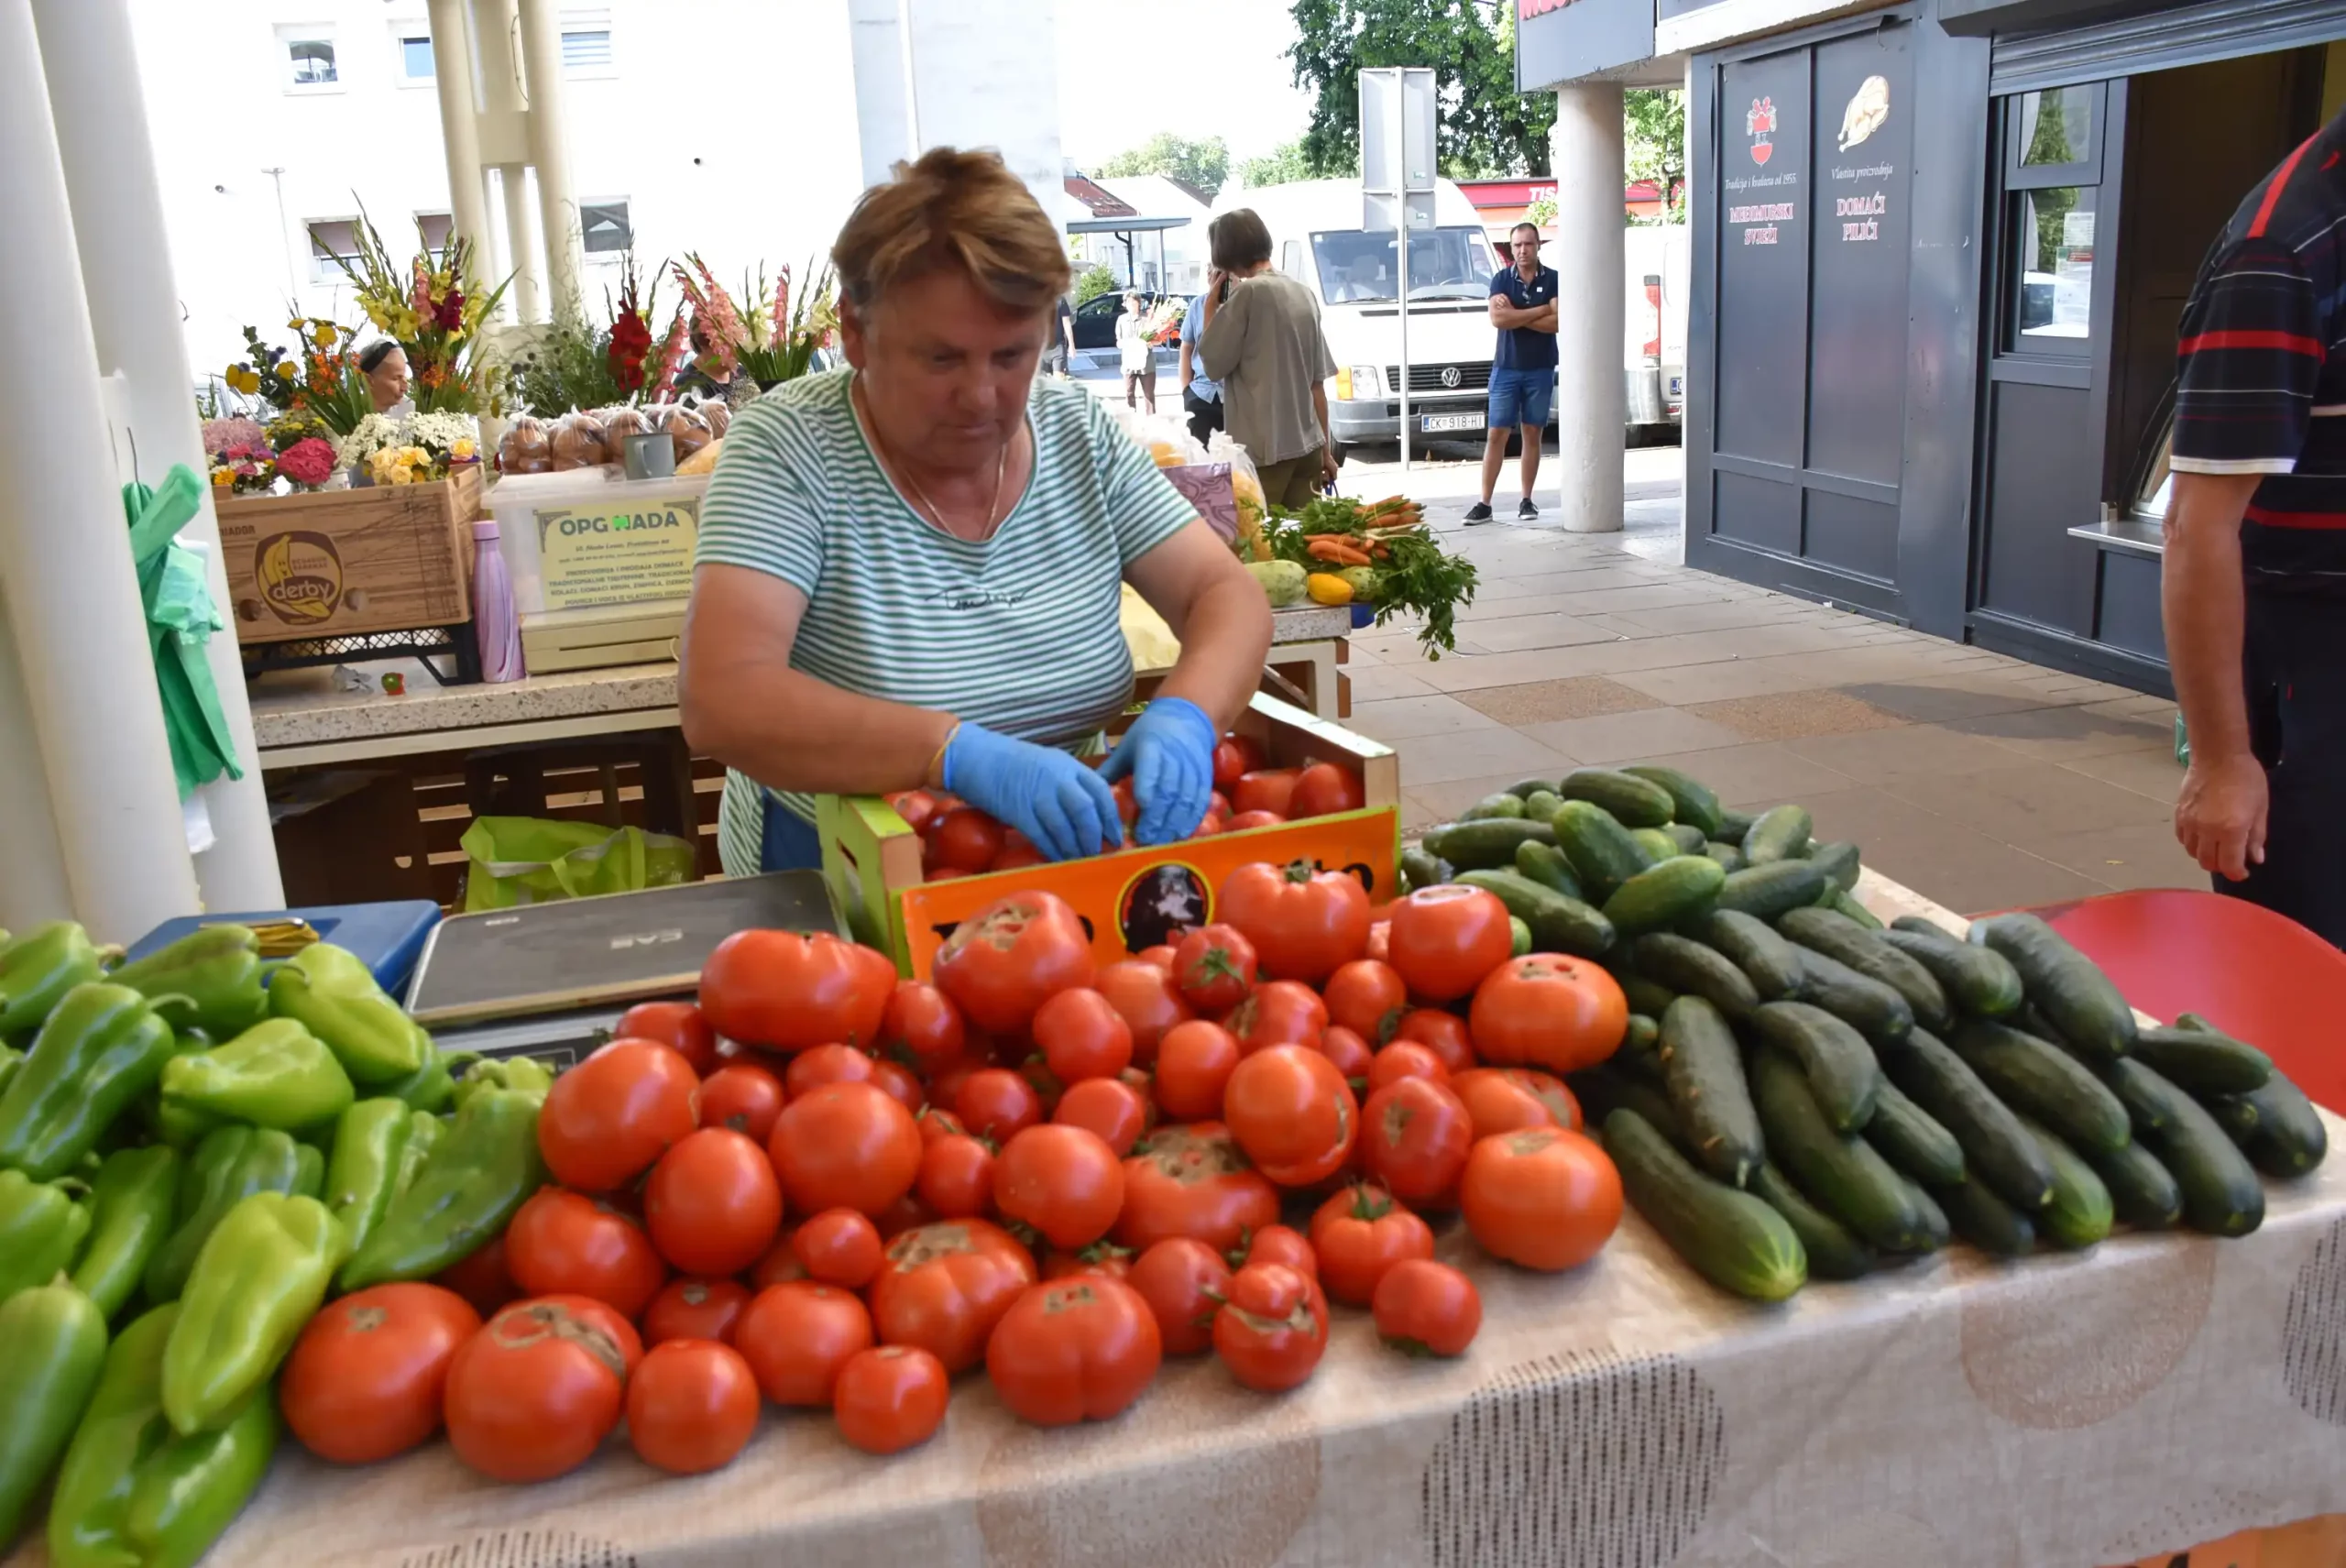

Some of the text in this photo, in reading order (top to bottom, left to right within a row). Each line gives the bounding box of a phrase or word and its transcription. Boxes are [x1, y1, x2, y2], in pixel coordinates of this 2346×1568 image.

[1836, 191, 1886, 216] DOMAĆI
[1744, 223, 1778, 246] SVJEŽI
[1842, 217, 1878, 241] PILIĆI
[220, 525, 257, 536] UADOR
[560, 517, 609, 536] OPG
[272, 579, 330, 601] derby
